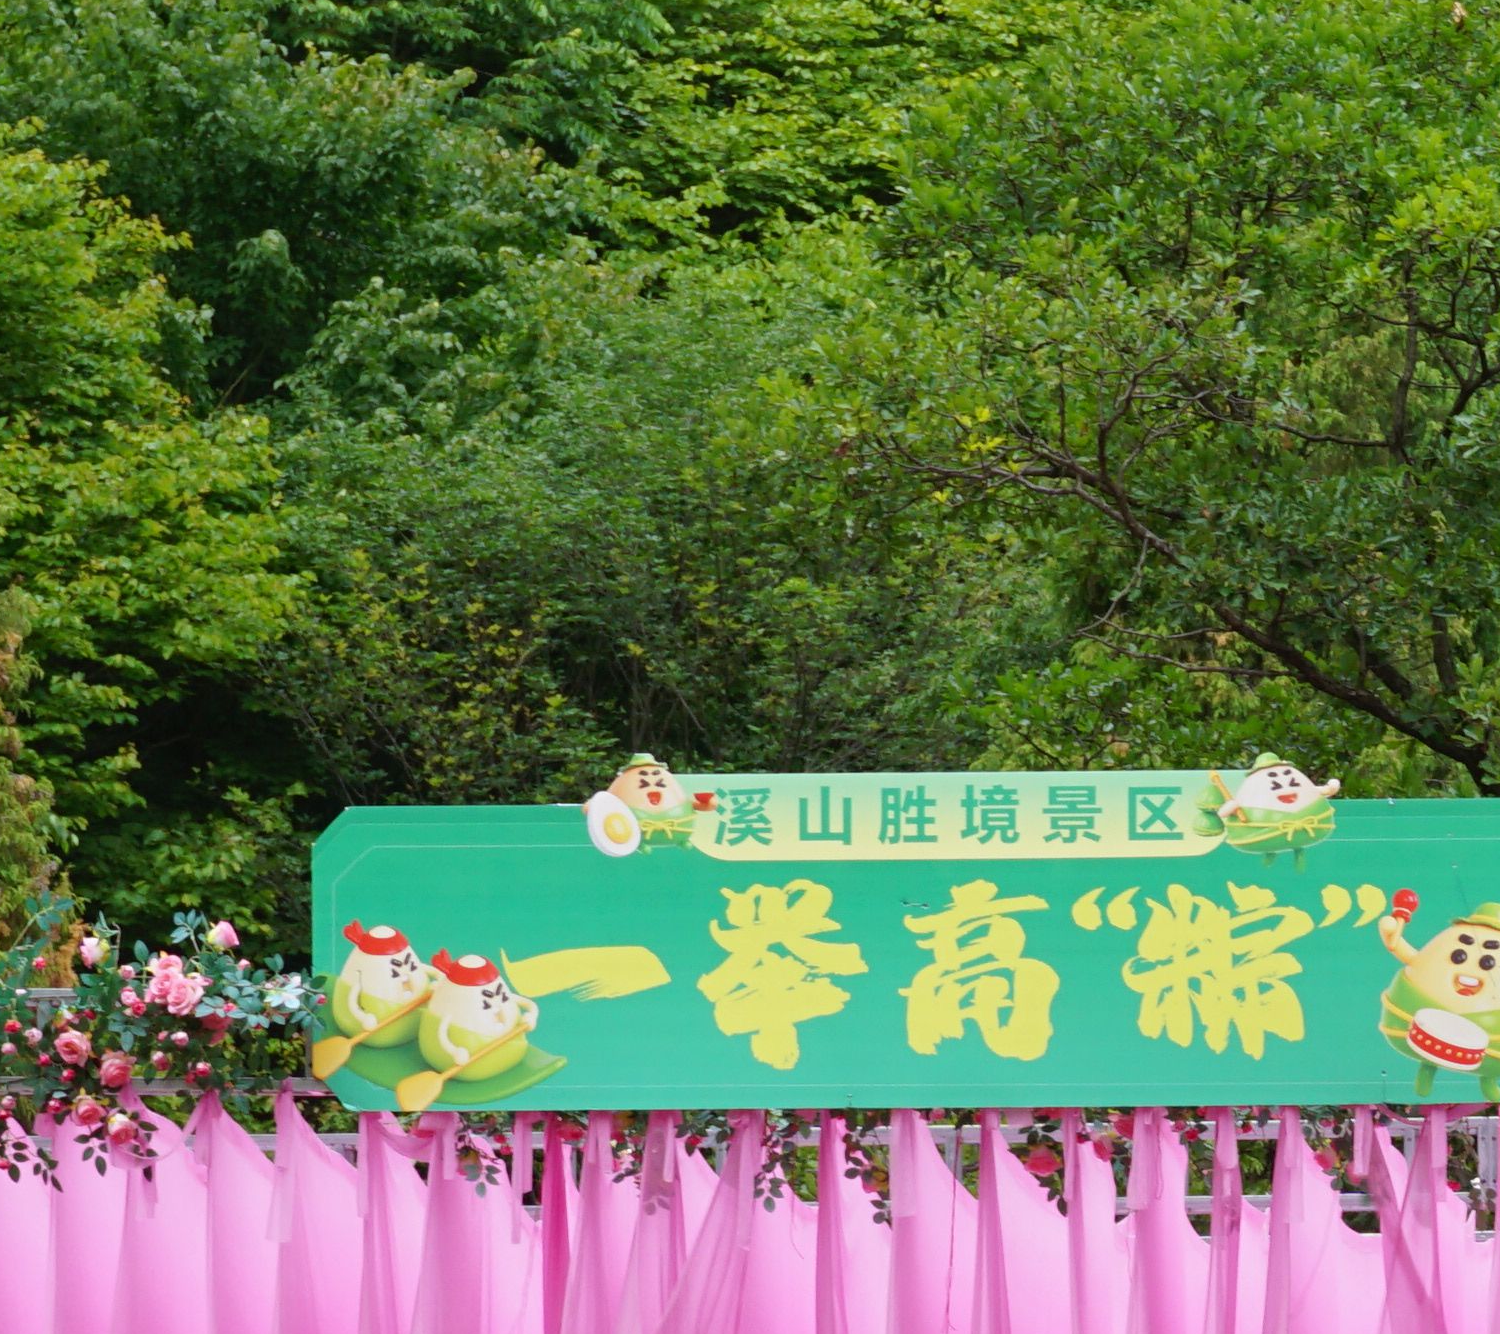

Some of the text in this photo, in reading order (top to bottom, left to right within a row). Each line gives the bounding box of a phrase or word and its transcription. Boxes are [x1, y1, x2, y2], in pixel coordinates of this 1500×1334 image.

[714, 784, 1185, 846] 溪山胜境景区
